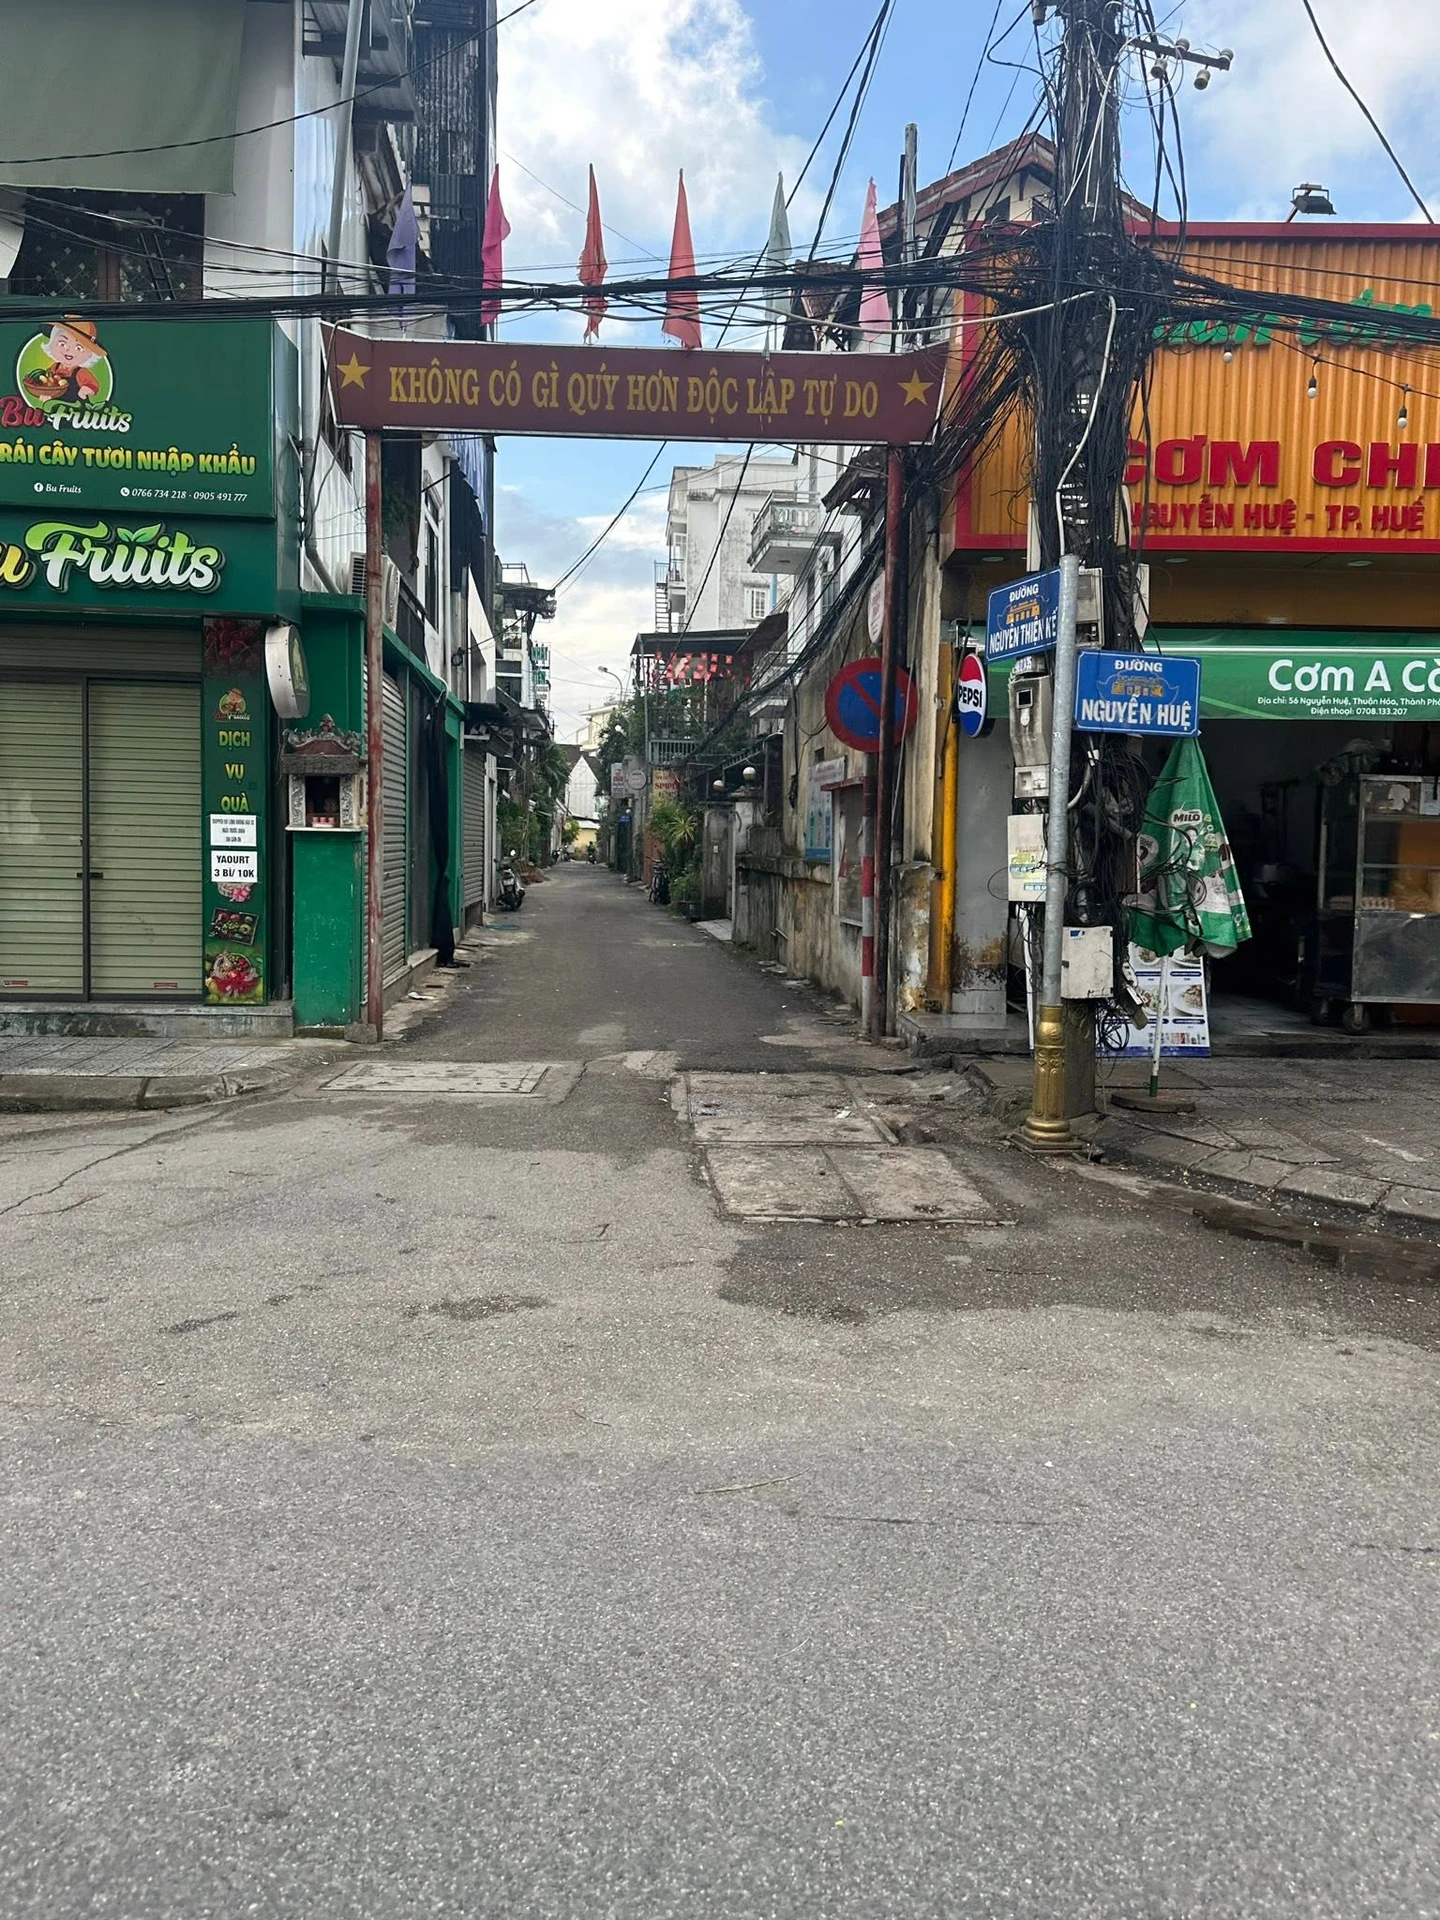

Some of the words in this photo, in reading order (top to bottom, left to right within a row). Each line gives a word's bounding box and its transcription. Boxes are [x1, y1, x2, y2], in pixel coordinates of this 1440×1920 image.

[389, 357, 480, 406] KHÔNG
[488, 360, 522, 407] CÓ
[532, 360, 560, 408] GÌ
[626, 368, 680, 413] HƠN
[687, 367, 739, 425] ĐỘC
[747, 367, 796, 424] LẬP
[803, 373, 838, 426] TỰ
[843, 380, 879, 419] DO
[0, 395, 45, 428] Bu
[44, 400, 133, 433] Fruits
[39, 440, 78, 467] CÂY
[83, 446, 132, 470] TƯƠI
[138, 446, 195, 477] NHẬP
[199, 443, 256, 475] KHẨU
[46, 484, 58, 492] Bu
[59, 485, 82, 494] Fruits
[132, 488, 152, 498] 0766
[154, 489, 169, 499] 734
[171, 490, 187, 500] 218
[194, 491, 215, 501] 0905
[1243, 499, 1297, 535] HUỆ
[1325, 505, 1362, 531] TP.
[1371, 495, 1425, 532] HUẾ
[25, 521, 219, 589] Fruits
[1009, 583, 1039, 603] ĐƯỜNG
[1020, 616, 1043, 646] THIỆN
[1114, 659, 1163, 673] ĐƯỜNG
[1268, 659, 1355, 692] Cơm
[1364, 660, 1392, 692] A
[958, 685, 983, 708] PEPSI
[1257, 696, 1272, 706] Địa
[1288, 697, 1299, 705] 56
[1300, 695, 1332, 707] Nguyễn
[1333, 696, 1351, 706] Huệ,
[1353, 697, 1378, 706] Thuận
[1401, 697, 1426, 706] Thành
[1081, 693, 1152, 725] NGUYỄN
[1157, 701, 1192, 731] HUỆ
[1310, 706, 1330, 716] Điện
[1330, 706, 1354, 716] thoại:
[1356, 707, 1408, 716] 0708.133.207
[219, 730, 251, 751] DỊCH
[225, 763, 244, 784] VỤ
[221, 792, 249, 813] QUÀ
[1173, 813, 1200, 822] MILO
[216, 855, 250, 864] YAOURT
[214, 868, 220, 877] 3
[238, 869, 254, 878] 10K
